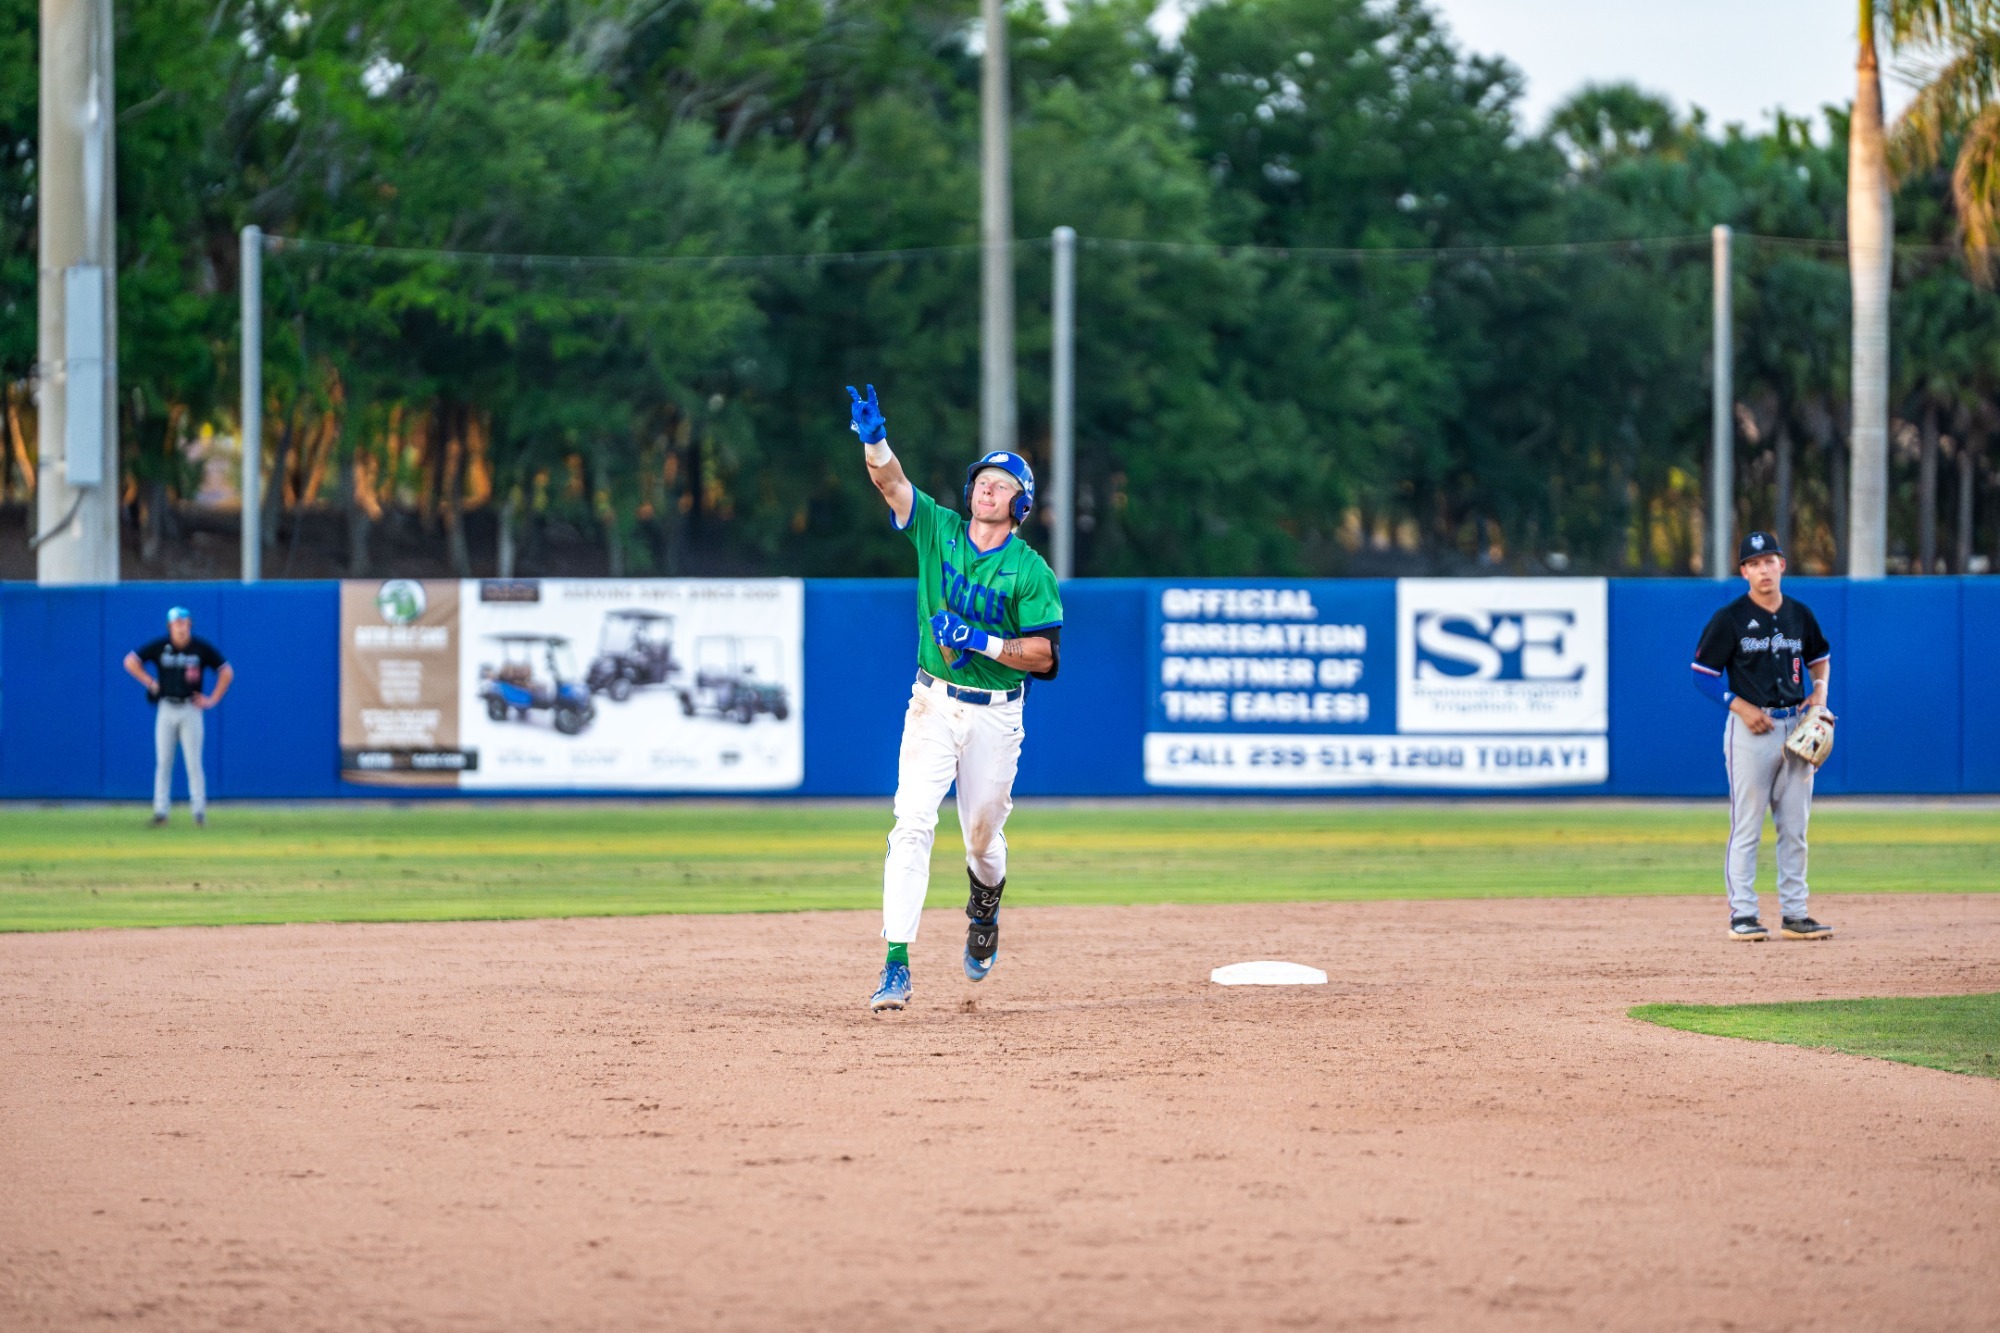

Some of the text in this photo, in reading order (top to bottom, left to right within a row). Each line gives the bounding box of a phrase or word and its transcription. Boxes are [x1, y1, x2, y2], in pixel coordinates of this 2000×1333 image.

[941, 561, 1007, 625] FGCU
[1161, 589, 1318, 618] OFFICIAL
[1161, 623, 1367, 654] IRRIGATION
[1741, 633, 1802, 654] West Georgi
[1161, 657, 1364, 689] PARTNER OF
[1161, 691, 1370, 723] THE EAGLES!
[1167, 744, 1234, 767] CALL
[1476, 746, 1589, 769] TODAY!
